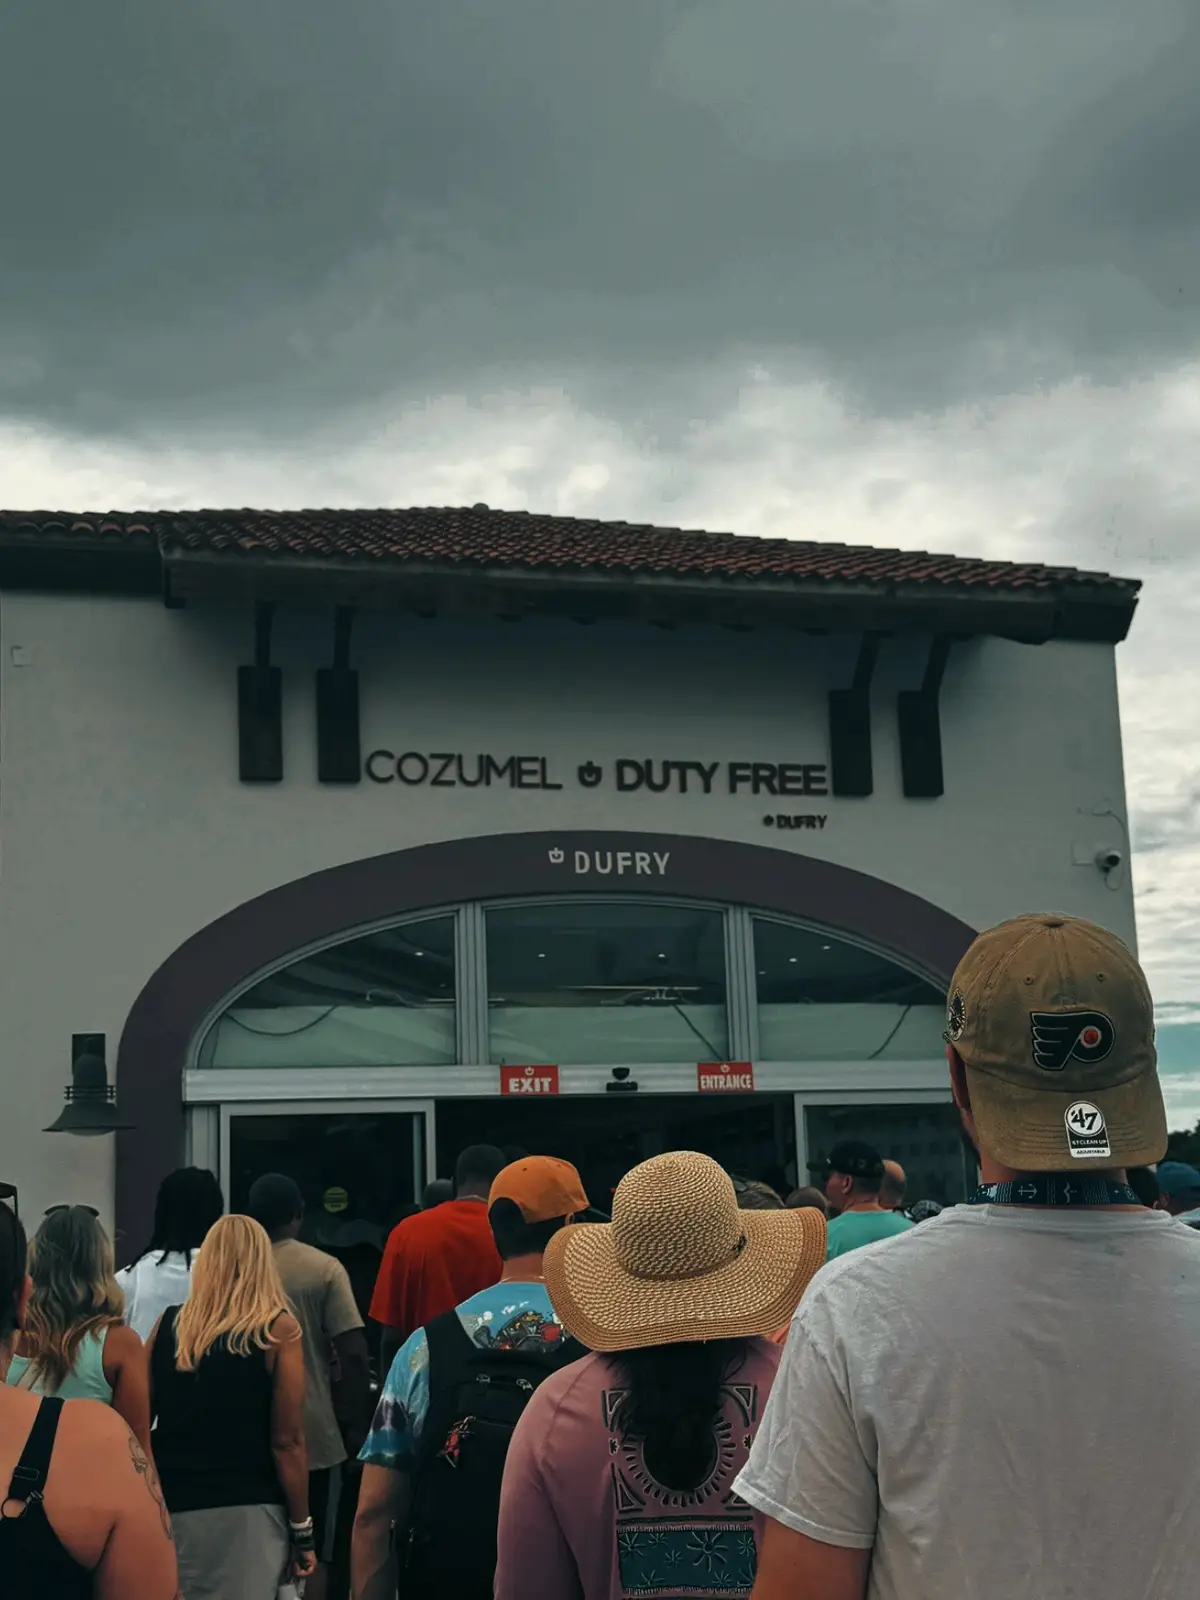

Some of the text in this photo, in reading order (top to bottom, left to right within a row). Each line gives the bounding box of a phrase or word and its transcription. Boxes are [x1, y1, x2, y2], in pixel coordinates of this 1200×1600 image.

[365, 749, 828, 796] COZUMEL DUTY FREE
[776, 814, 828, 830] DUFRY
[574, 850, 671, 876] DUFRY
[508, 1077, 552, 1093] EXIT
[700, 1074, 752, 1090] ENTRANCE
